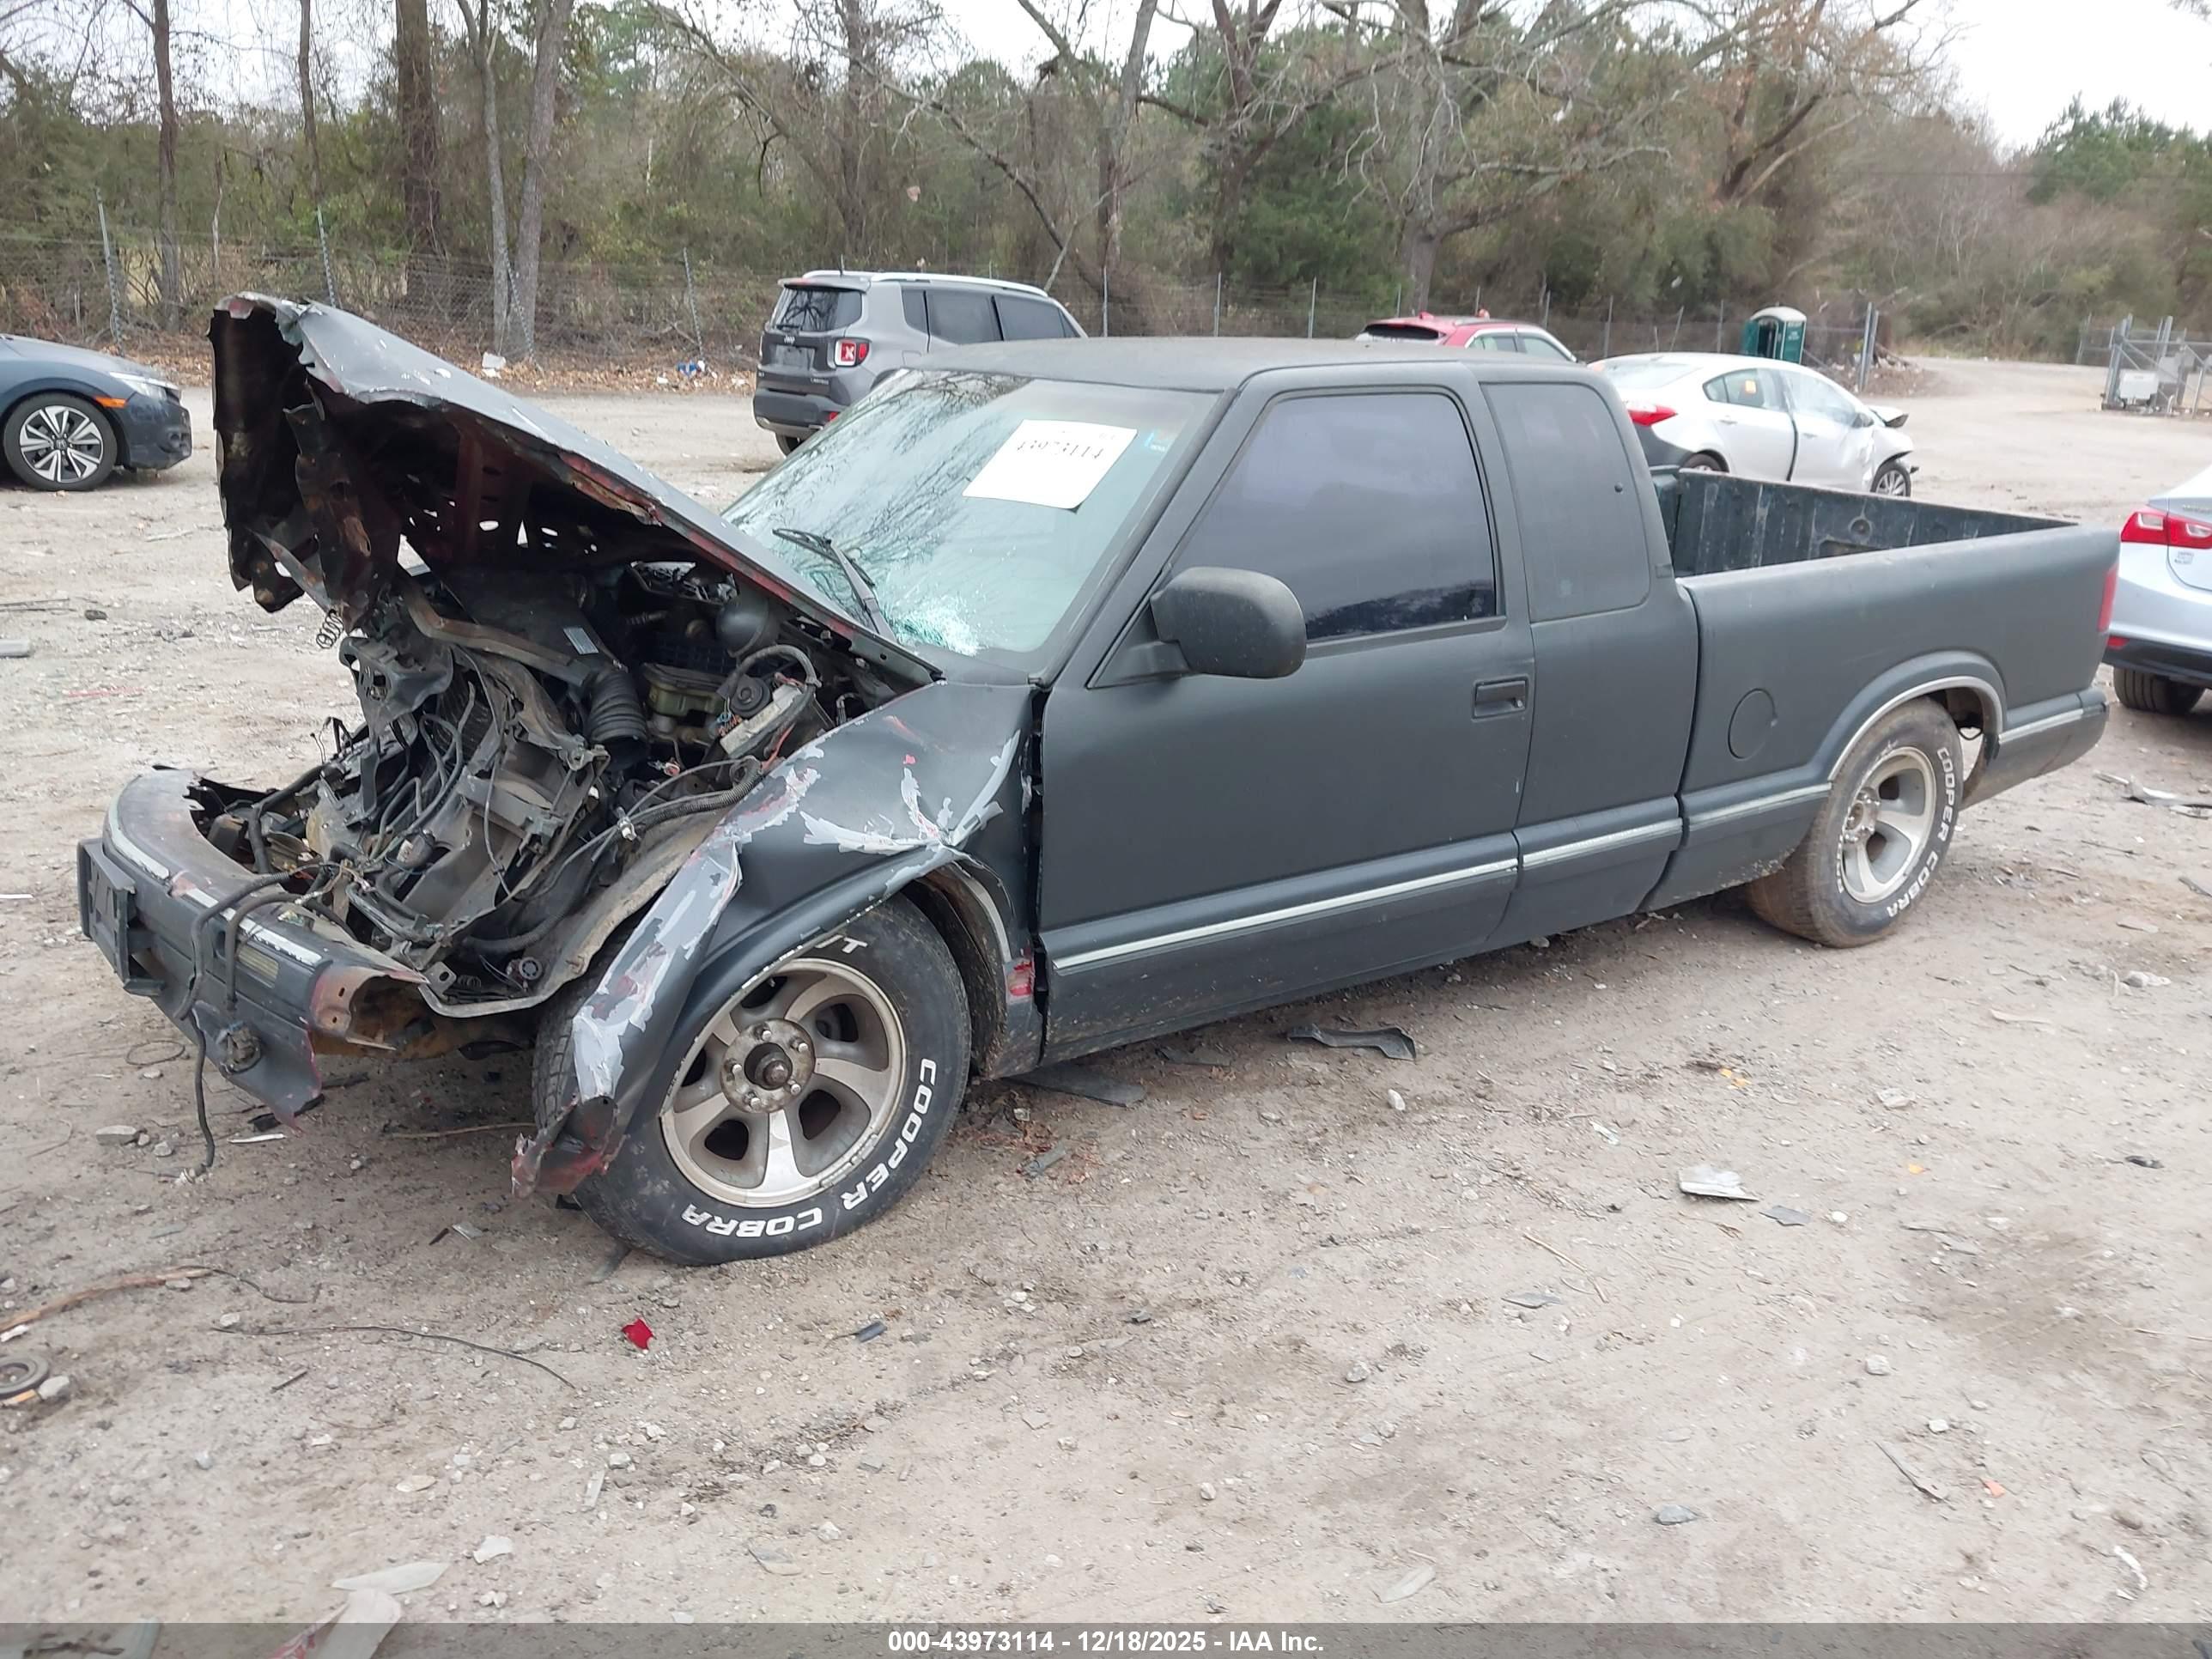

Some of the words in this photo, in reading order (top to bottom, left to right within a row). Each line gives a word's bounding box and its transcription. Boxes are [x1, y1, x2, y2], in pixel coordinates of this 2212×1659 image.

[1936, 747, 1956, 842] COOPER
[1886, 850, 1939, 918] COBRA
[841, 1058, 937, 1211] COOPER
[681, 1203, 824, 1237] COBRA
